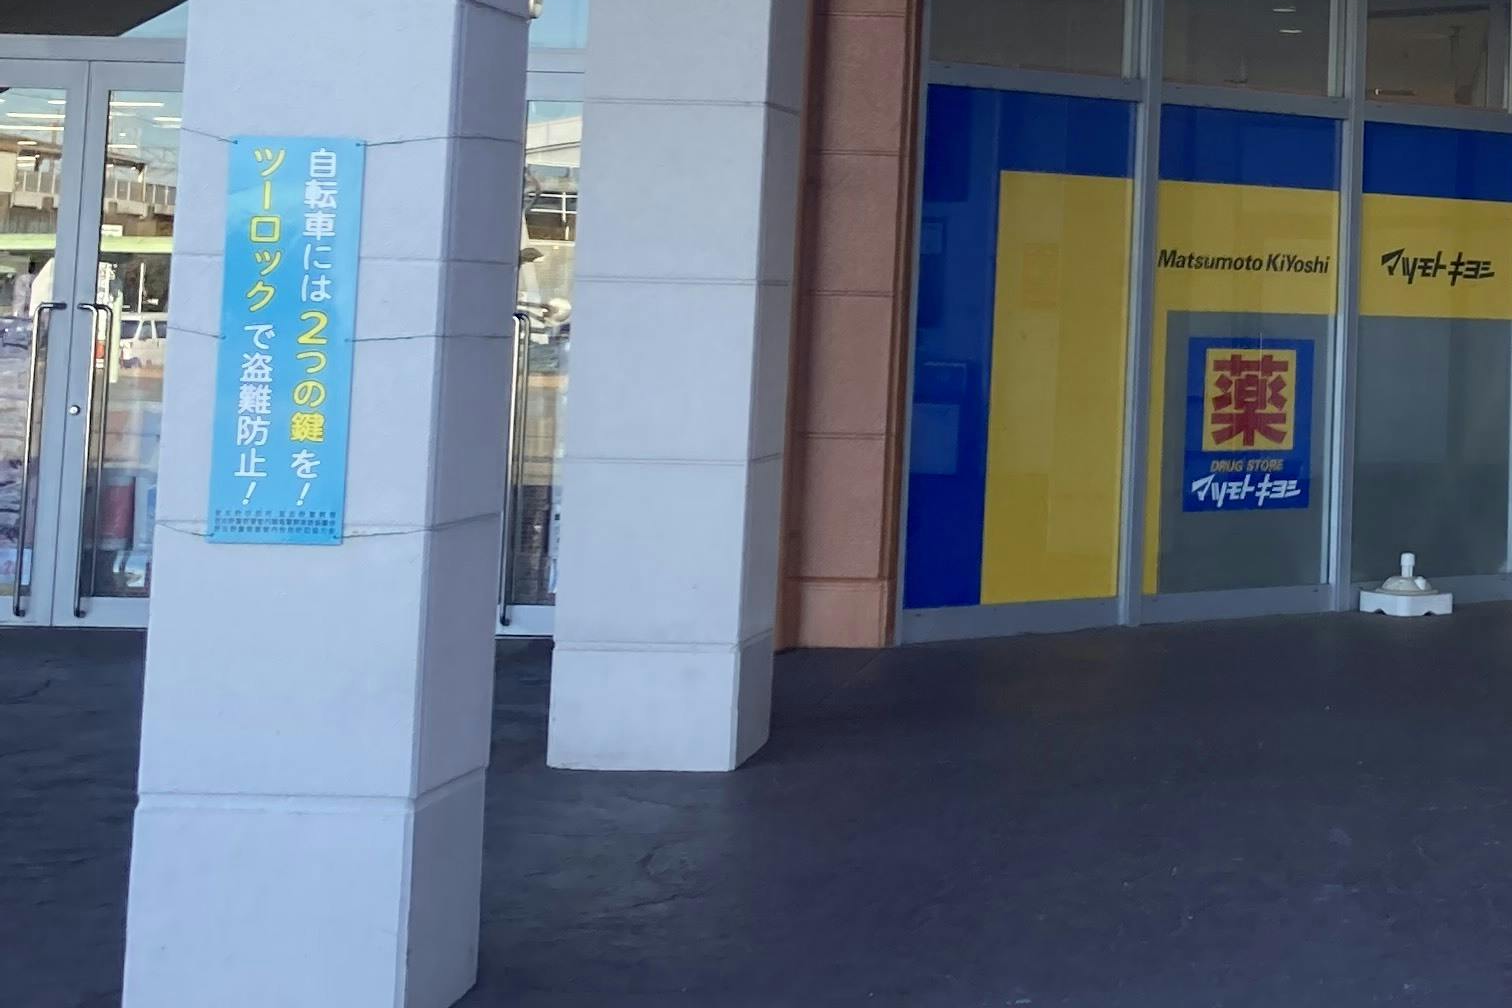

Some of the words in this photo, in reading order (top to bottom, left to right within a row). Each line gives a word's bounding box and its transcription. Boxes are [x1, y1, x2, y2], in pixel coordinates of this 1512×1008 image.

[1157, 248, 1263, 271] Matsumoto
[1265, 252, 1331, 274] KiYoshi
[1381, 248, 1495, 286] マツモトキヨシ
[1211, 354, 1289, 447] 薬
[1210, 459, 1244, 472] DRUG
[1247, 459, 1284, 472] STORE
[1191, 473, 1301, 508] マツモトキヨシ
